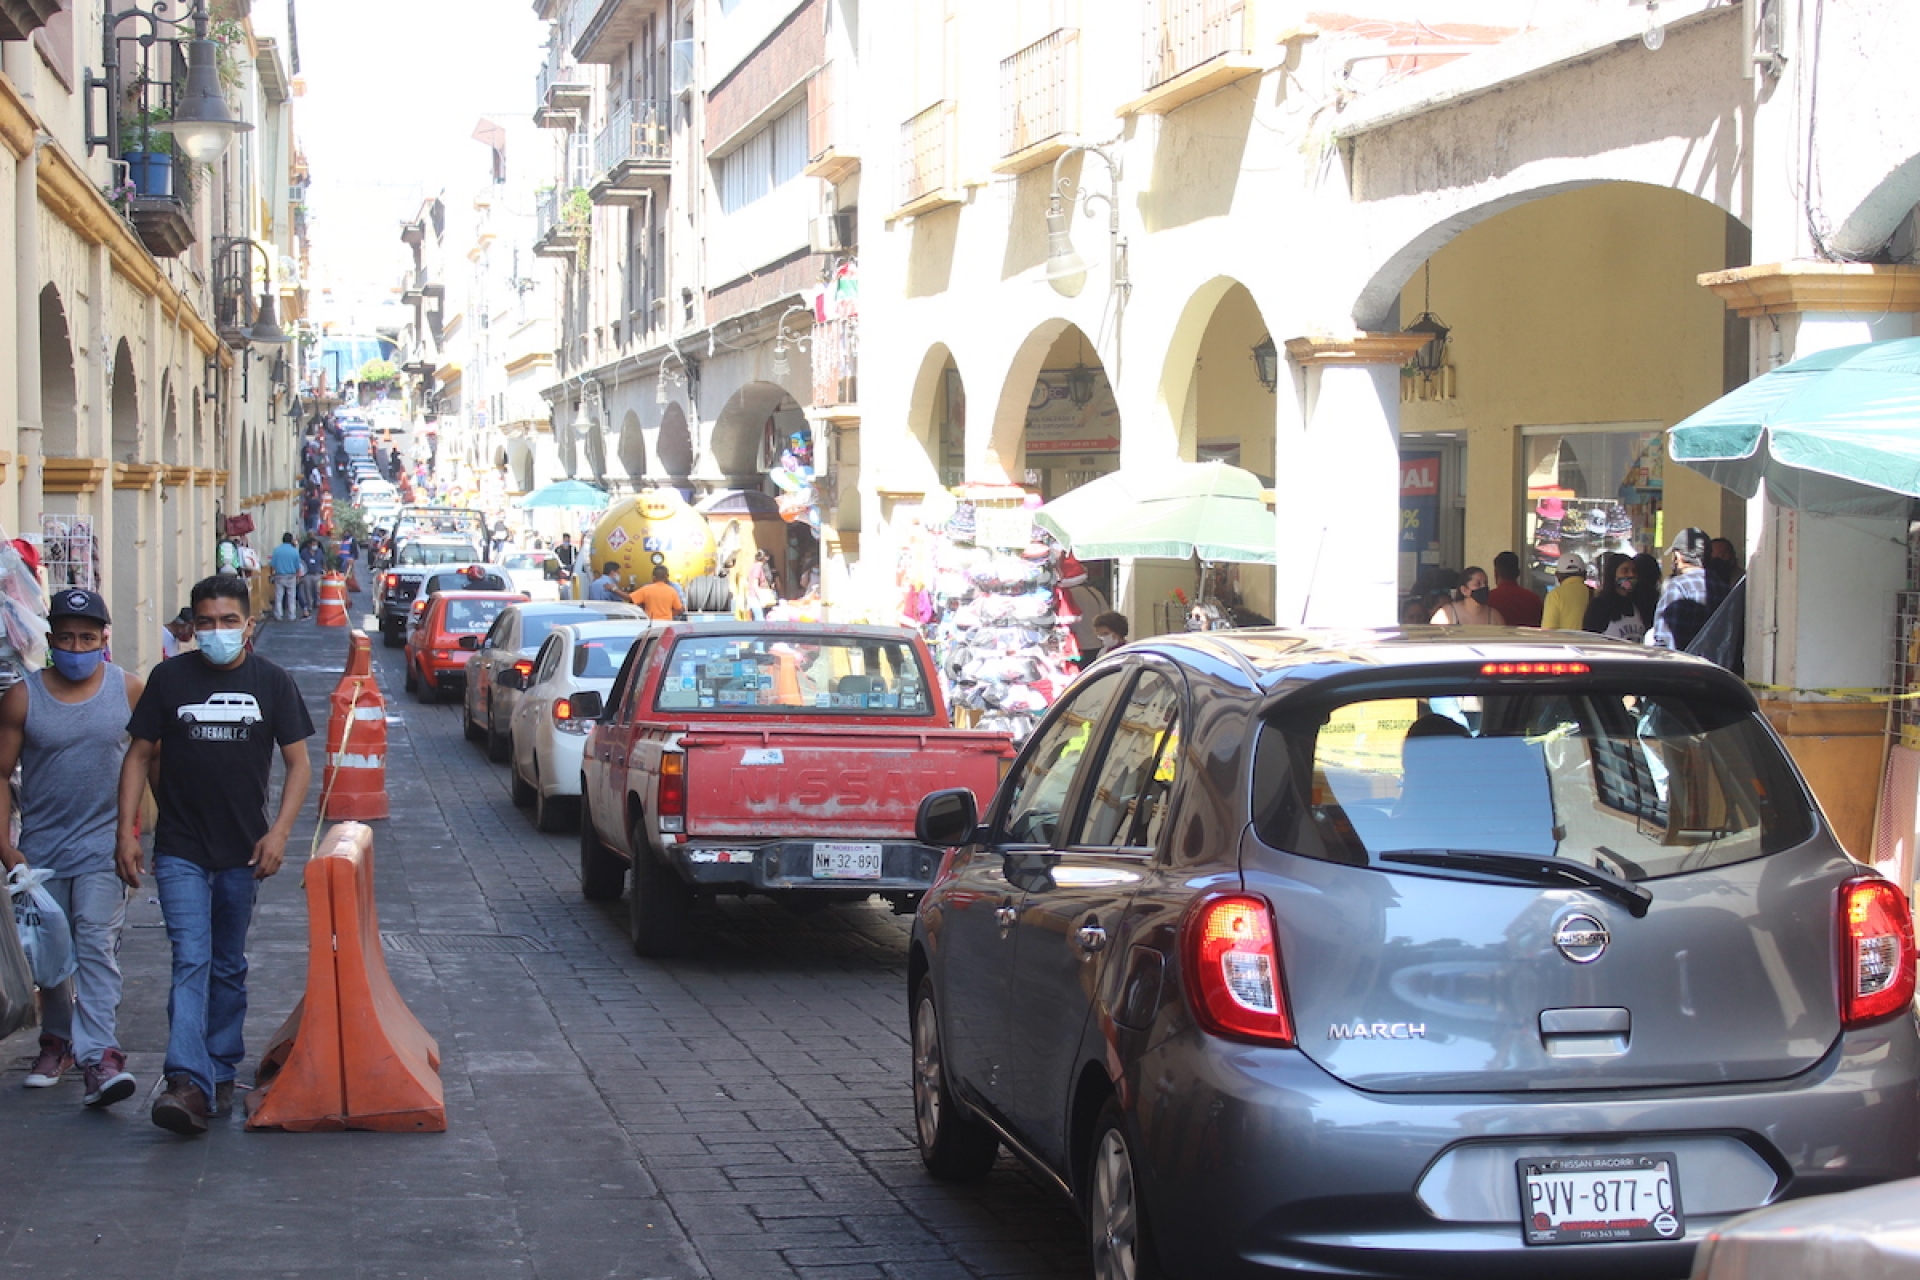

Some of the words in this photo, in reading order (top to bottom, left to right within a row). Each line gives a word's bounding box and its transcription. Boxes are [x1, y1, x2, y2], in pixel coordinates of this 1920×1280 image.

[202, 727, 238, 739] RENAULT
[731, 768, 956, 805] NISSAN
[815, 853, 880, 869] NW-32-890
[1328, 1023, 1425, 1039] MARCH
[1560, 1160, 1592, 1168] NISSAN
[1593, 1159, 1634, 1168] IRAGORRI
[1529, 1178, 1671, 1215] PVV-877-C
